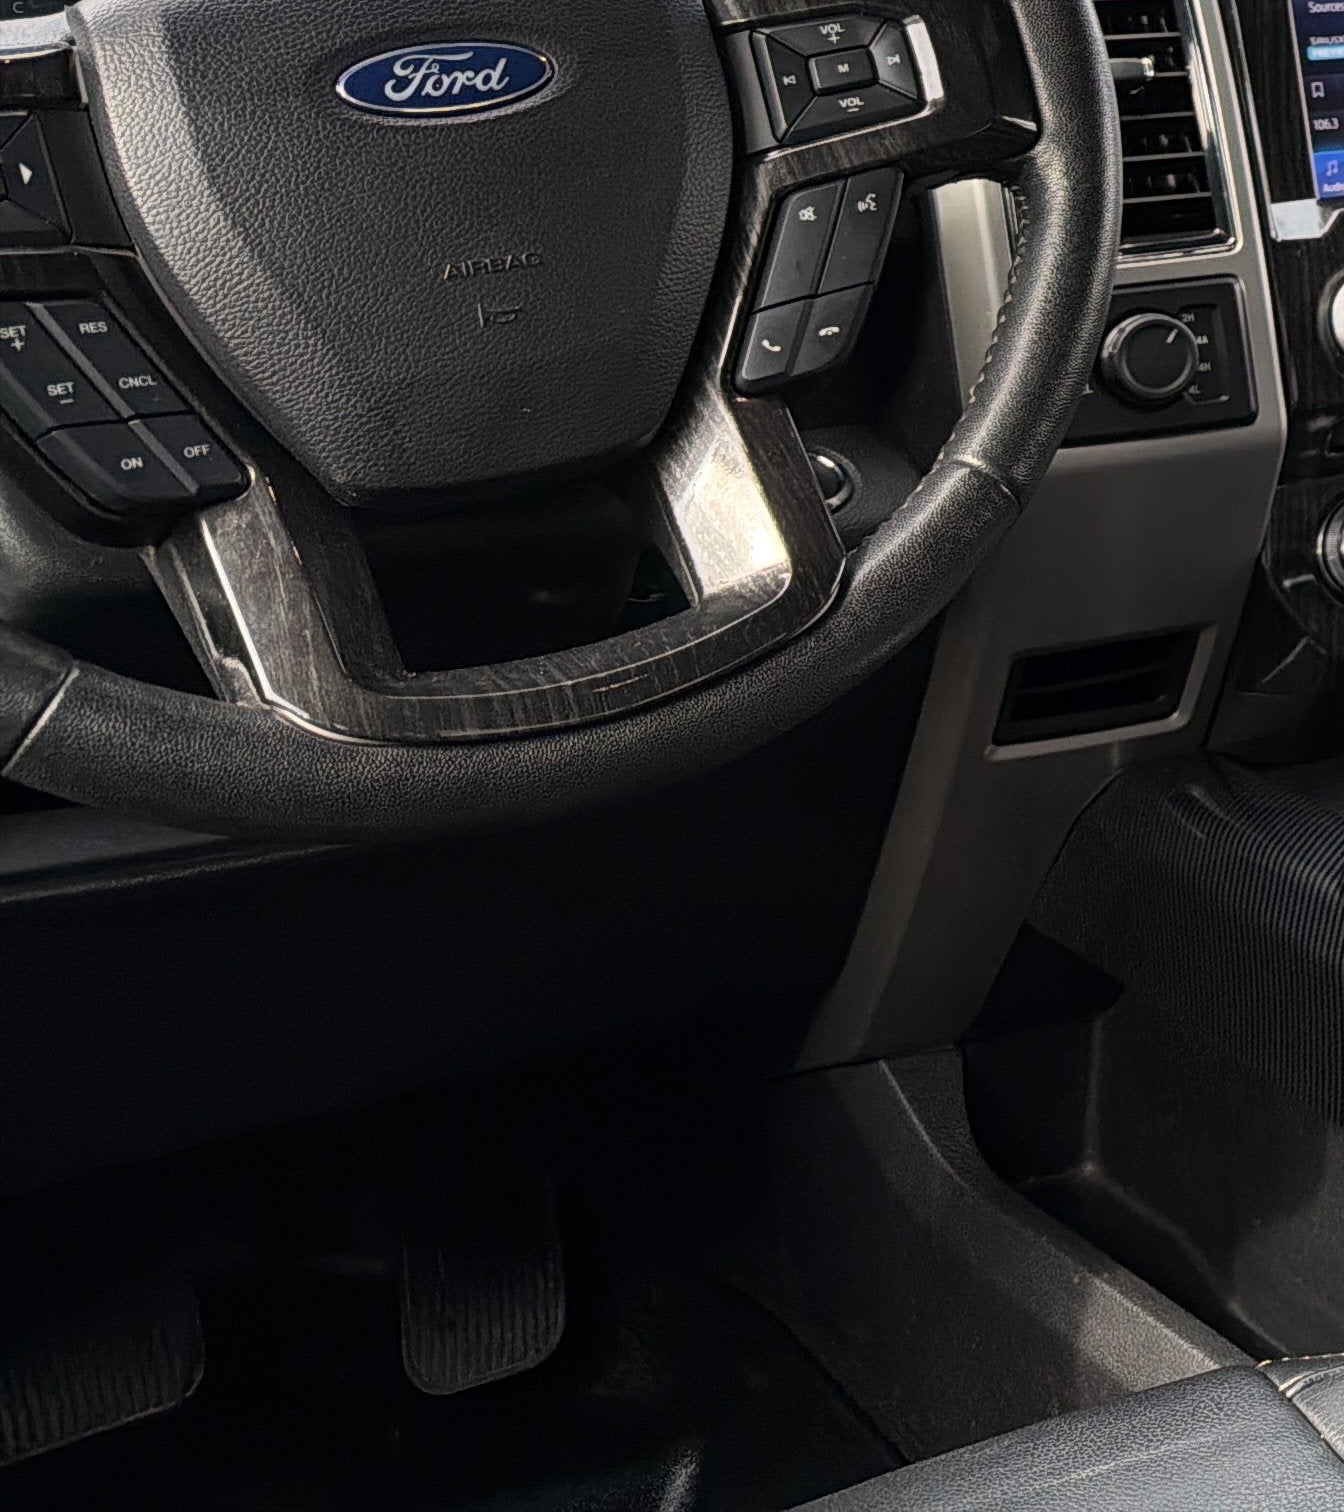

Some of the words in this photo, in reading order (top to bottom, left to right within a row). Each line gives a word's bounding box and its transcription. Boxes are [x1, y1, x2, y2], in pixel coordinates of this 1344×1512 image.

[819, 23, 845, 35] VOL
[838, 63, 850, 74] M
[384, 51, 511, 102] Ford
[838, 96, 865, 108] VOL
[443, 252, 542, 281] AIRBAG
[0, 324, 27, 338] SET
[78, 321, 108, 335] RES
[47, 381, 75, 397] SET
[118, 375, 158, 389] CNCL
[183, 443, 211, 459] OFF
[120, 456, 144, 471] ON
